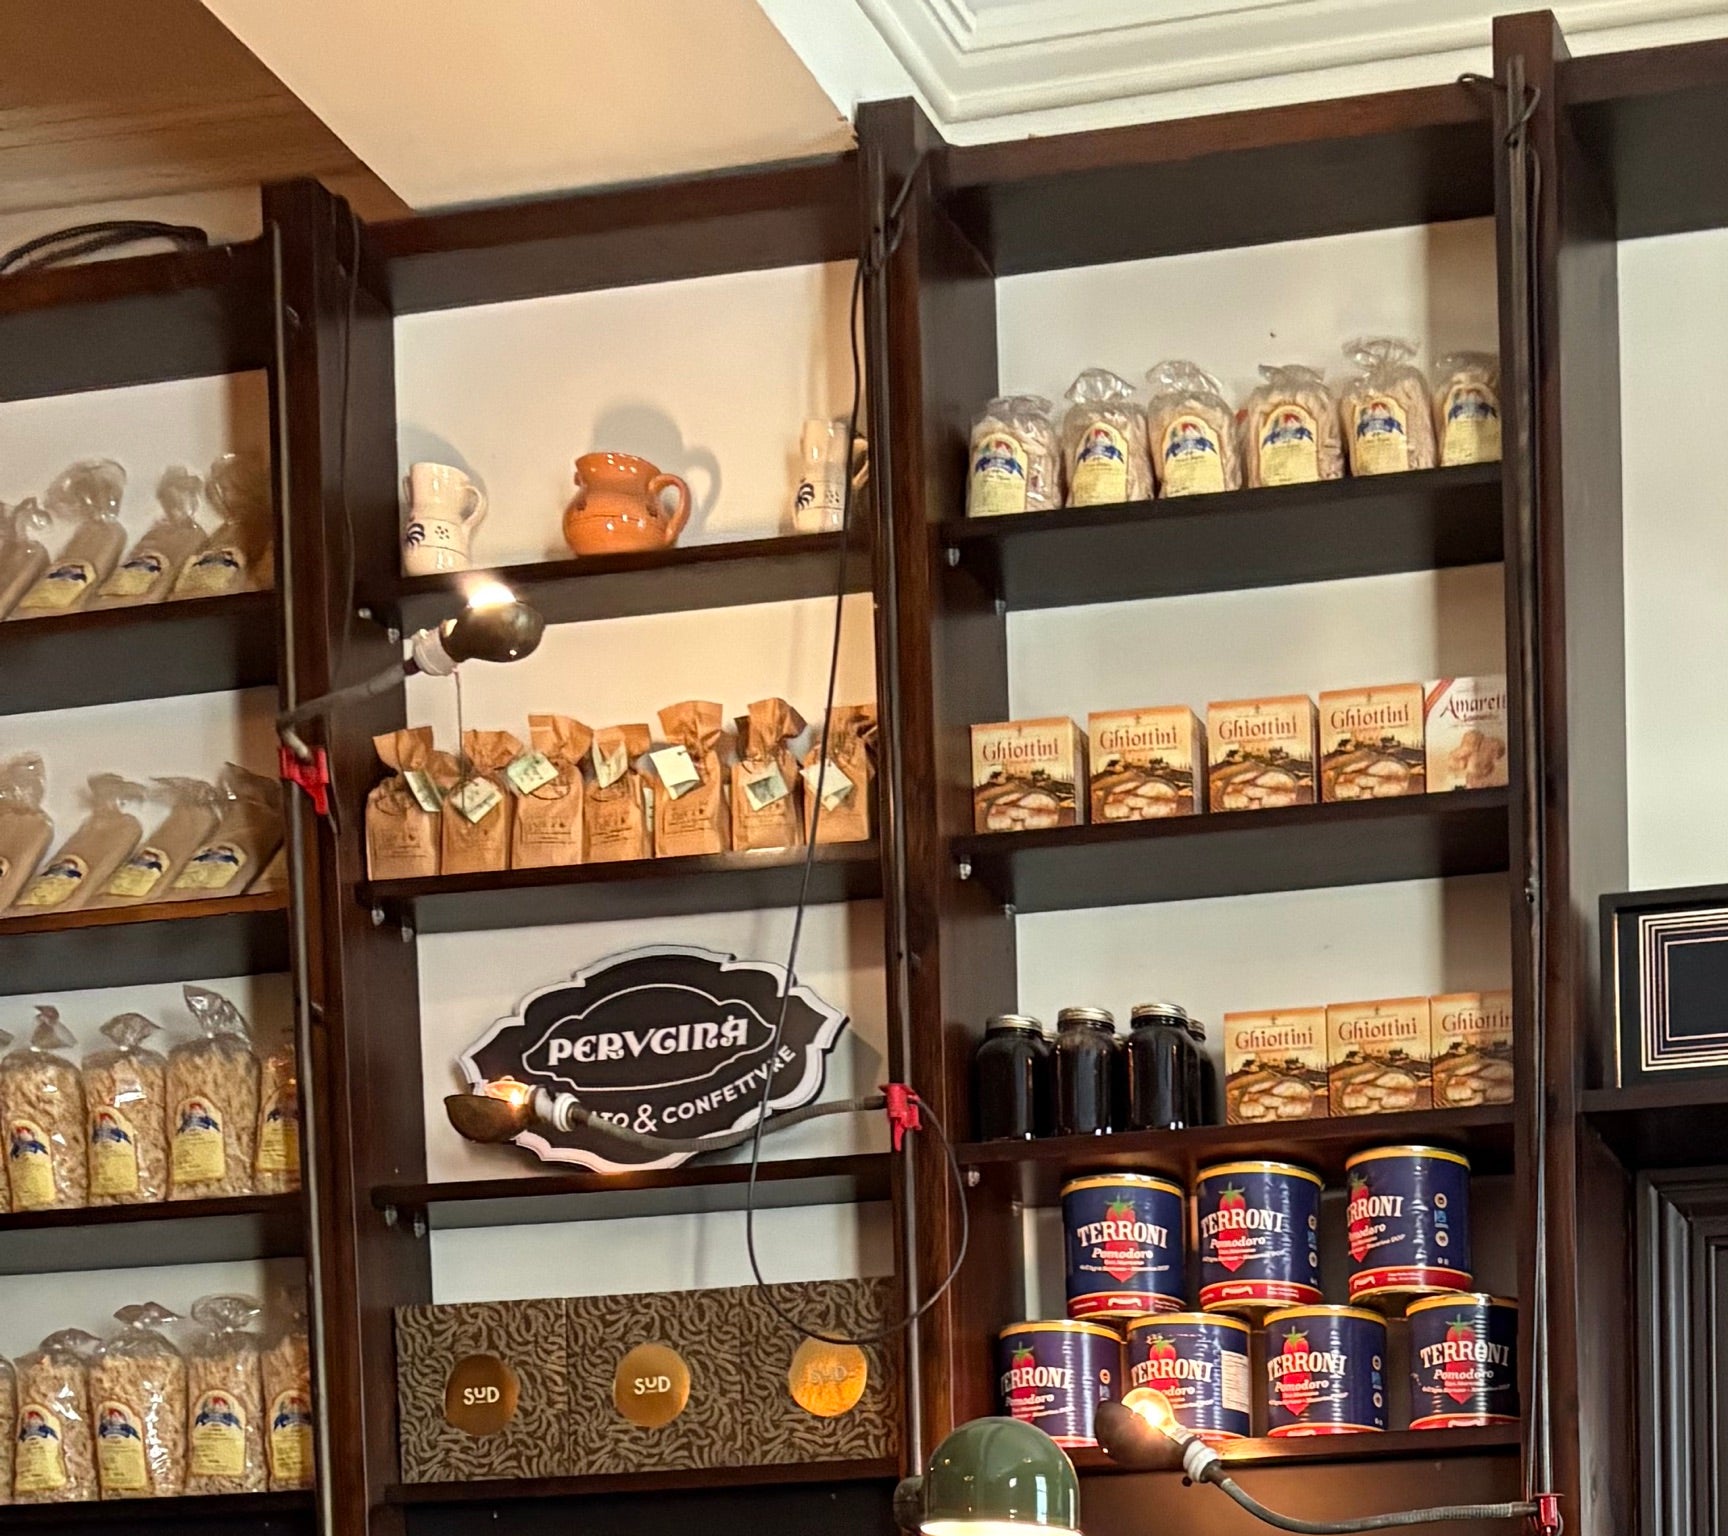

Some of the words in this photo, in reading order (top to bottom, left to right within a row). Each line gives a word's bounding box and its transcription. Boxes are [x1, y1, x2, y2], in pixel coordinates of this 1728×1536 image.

[1331, 704, 1409, 730] Ghiottini
[1440, 694, 1506, 719] Amarett
[1100, 727, 1177, 749] Ghiottini
[1219, 715, 1297, 740] Ghiottini
[983, 738, 1059, 761] Ghiottini
[1338, 1017, 1417, 1041] Ghiottini
[1441, 1008, 1511, 1033] Ghiotti
[1235, 1026, 1313, 1050] Ghiottini
[633, 1104, 657, 1134] &
[1077, 1220, 1168, 1248] TERRONI
[1201, 1208, 1290, 1239] TERRONI
[1267, 1351, 1347, 1381] TERRONI
[1420, 1340, 1510, 1368] TERRONI
[463, 1386, 500, 1405] SUD
[633, 1375, 671, 1396] SUD
